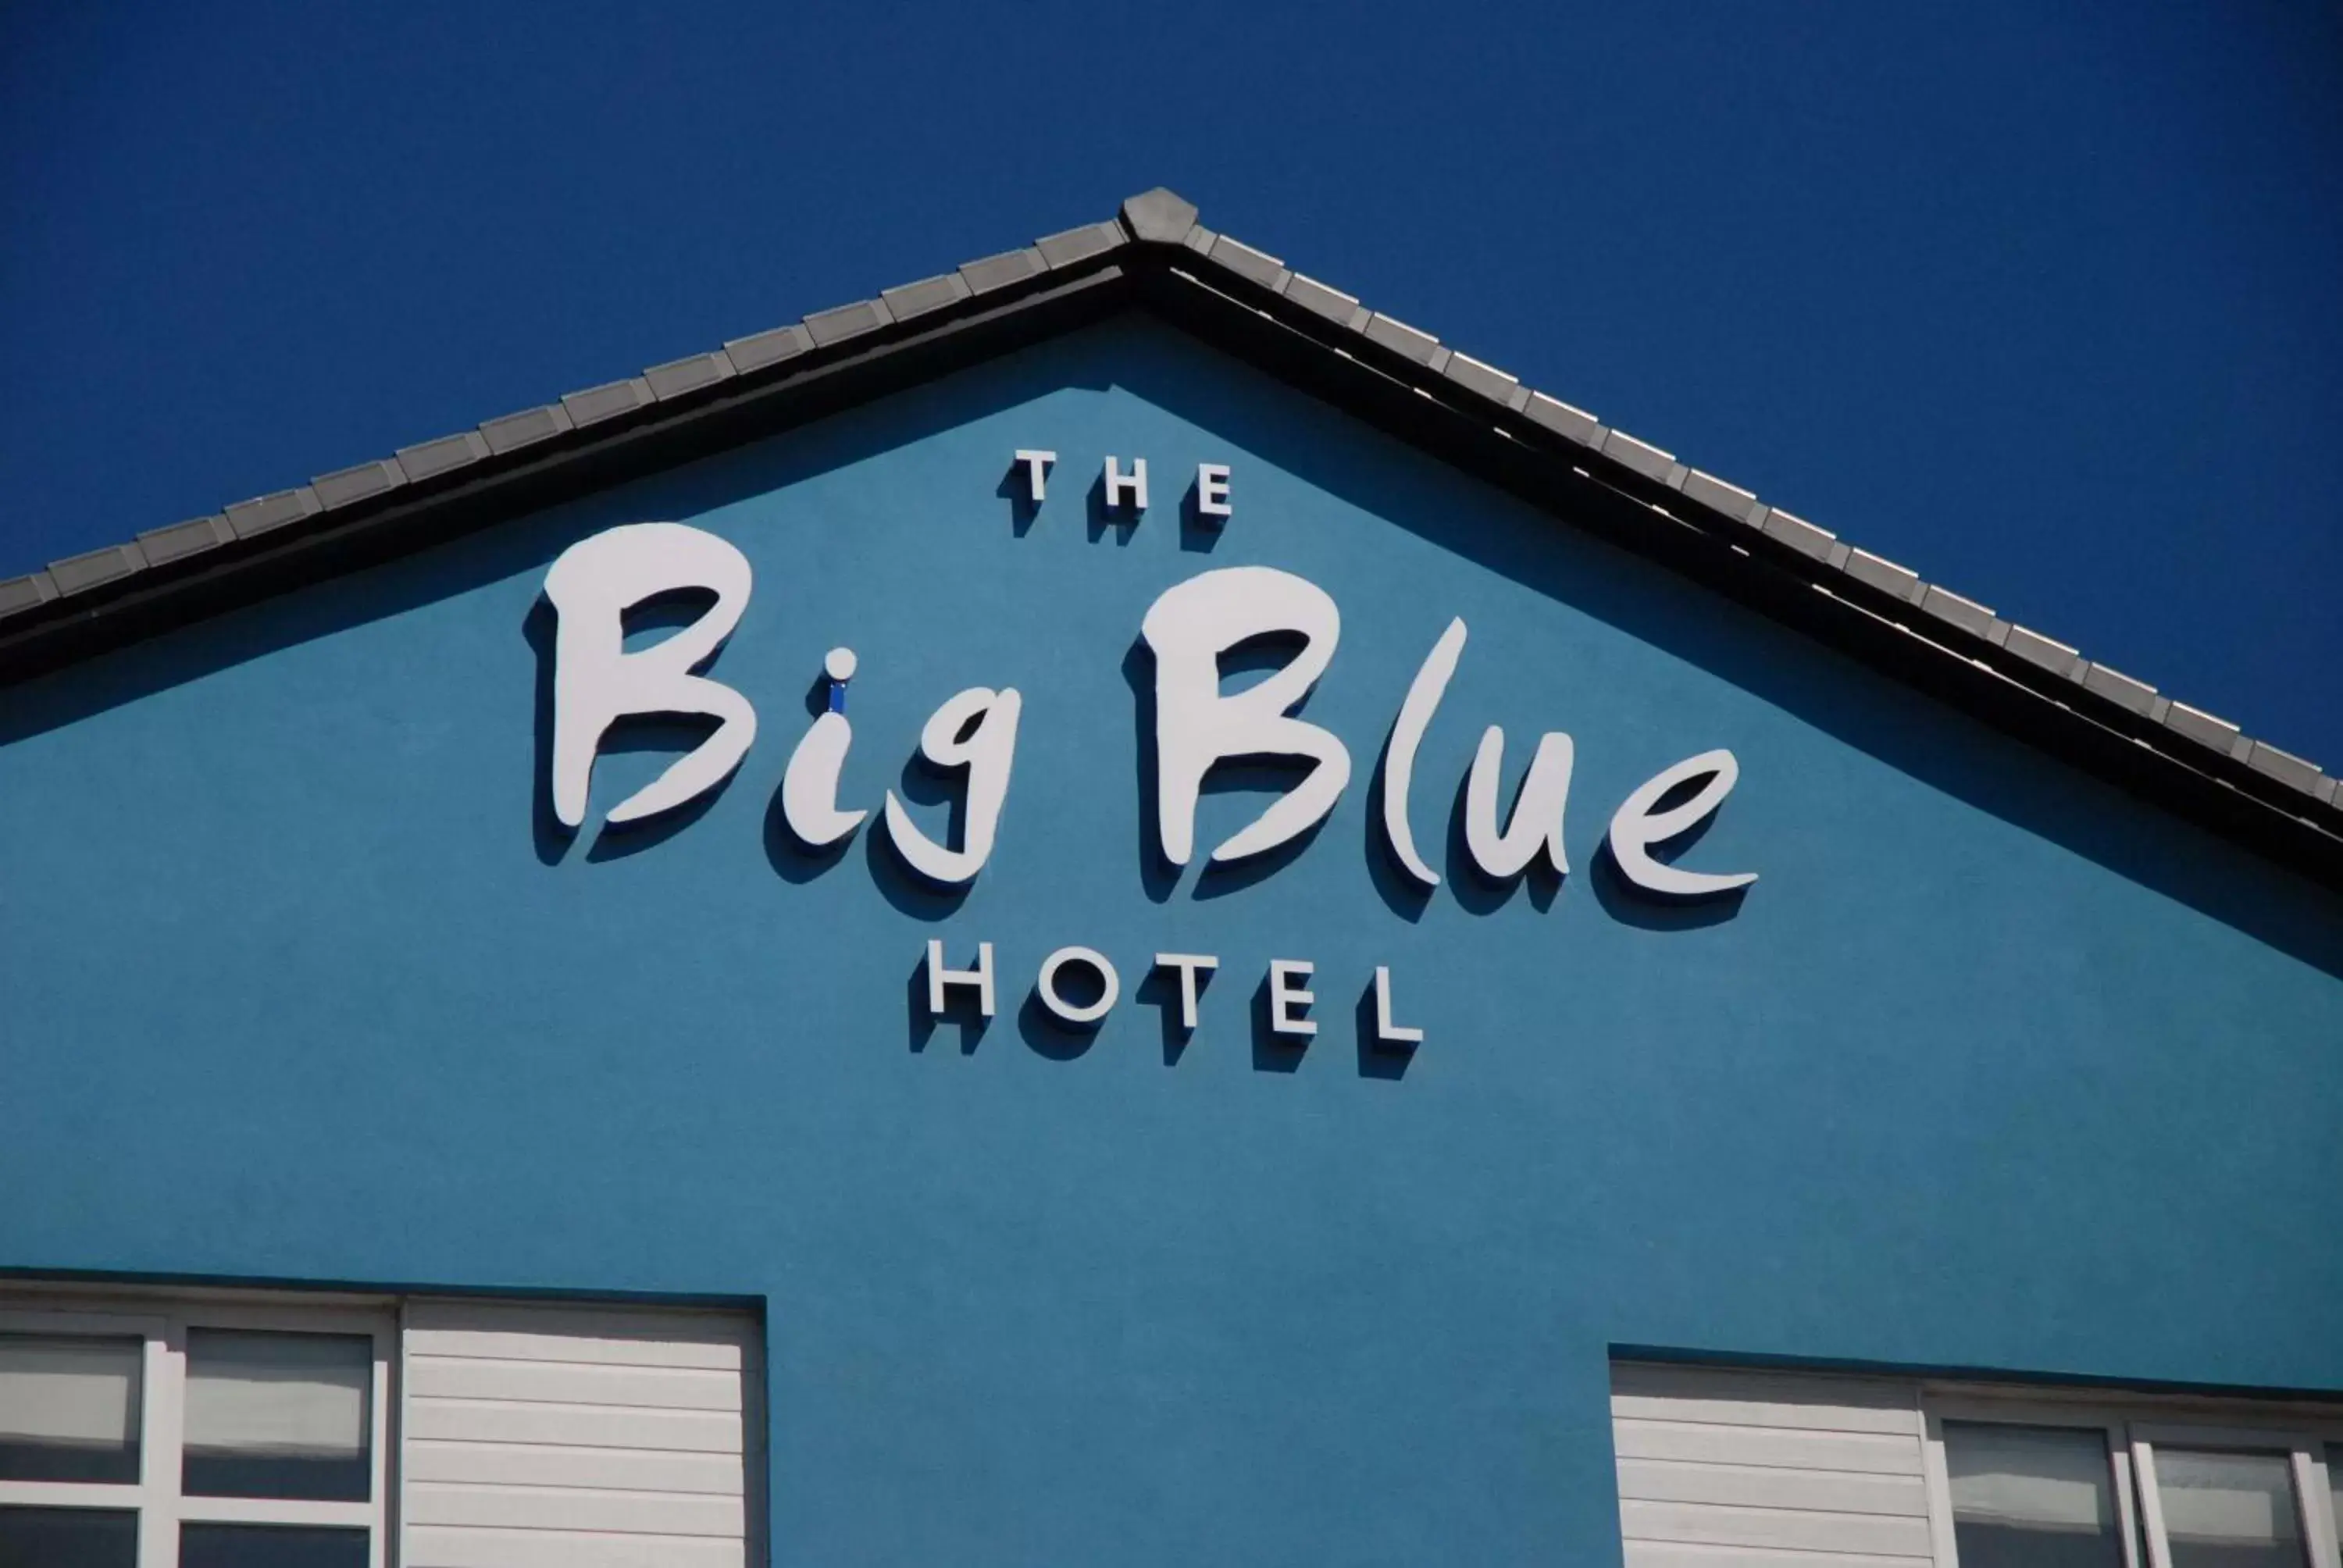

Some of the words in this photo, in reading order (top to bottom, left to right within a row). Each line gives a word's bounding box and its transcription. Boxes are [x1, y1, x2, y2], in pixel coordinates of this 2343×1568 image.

[1015, 448, 1233, 516] THE
[543, 522, 1022, 885] Big
[1141, 565, 1760, 896] Blue
[927, 939, 1425, 1042] HOTEL
